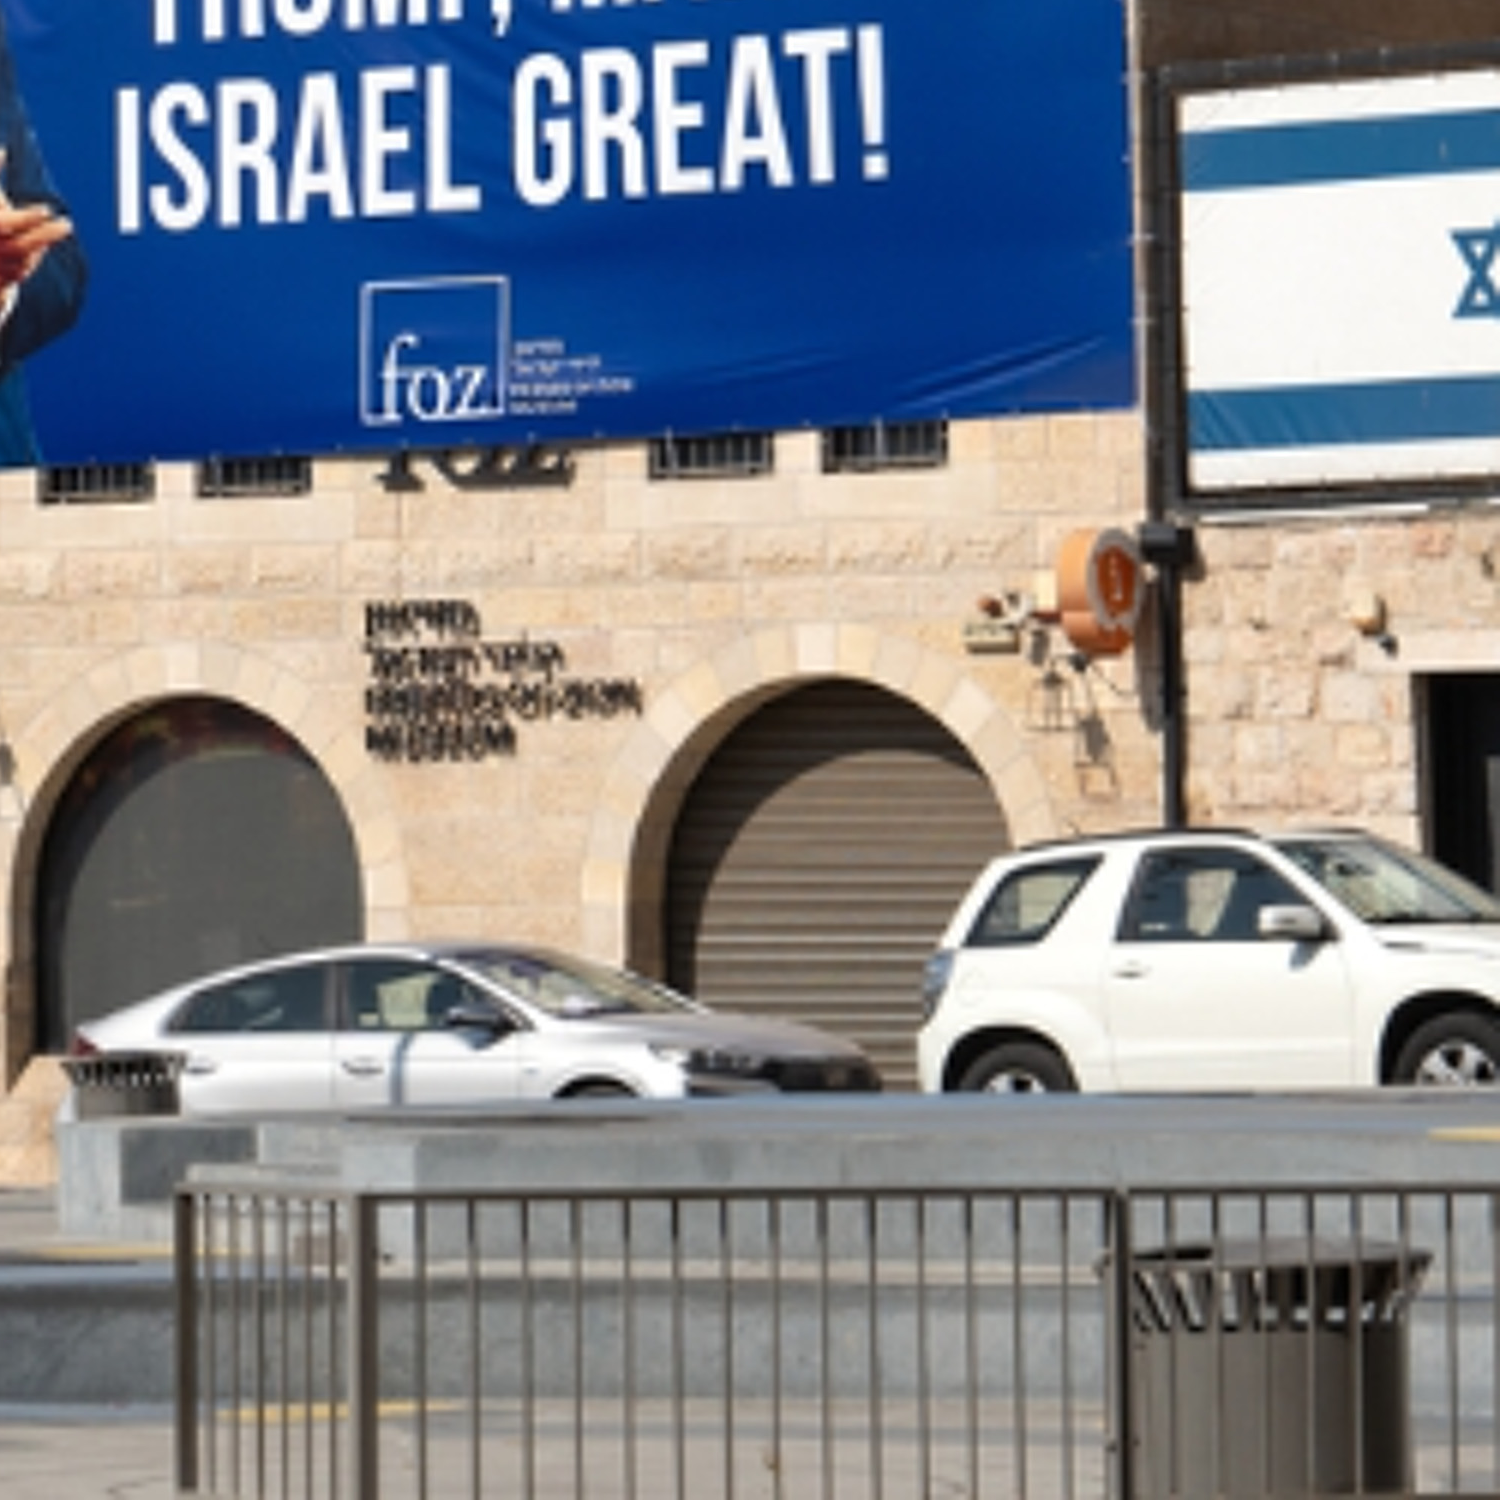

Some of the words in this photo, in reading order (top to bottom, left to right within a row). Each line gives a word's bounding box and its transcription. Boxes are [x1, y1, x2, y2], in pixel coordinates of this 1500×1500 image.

[115, 62, 482, 235] ISRAEL
[511, 22, 889, 207] GREAT!
[379, 333, 489, 421] foz
